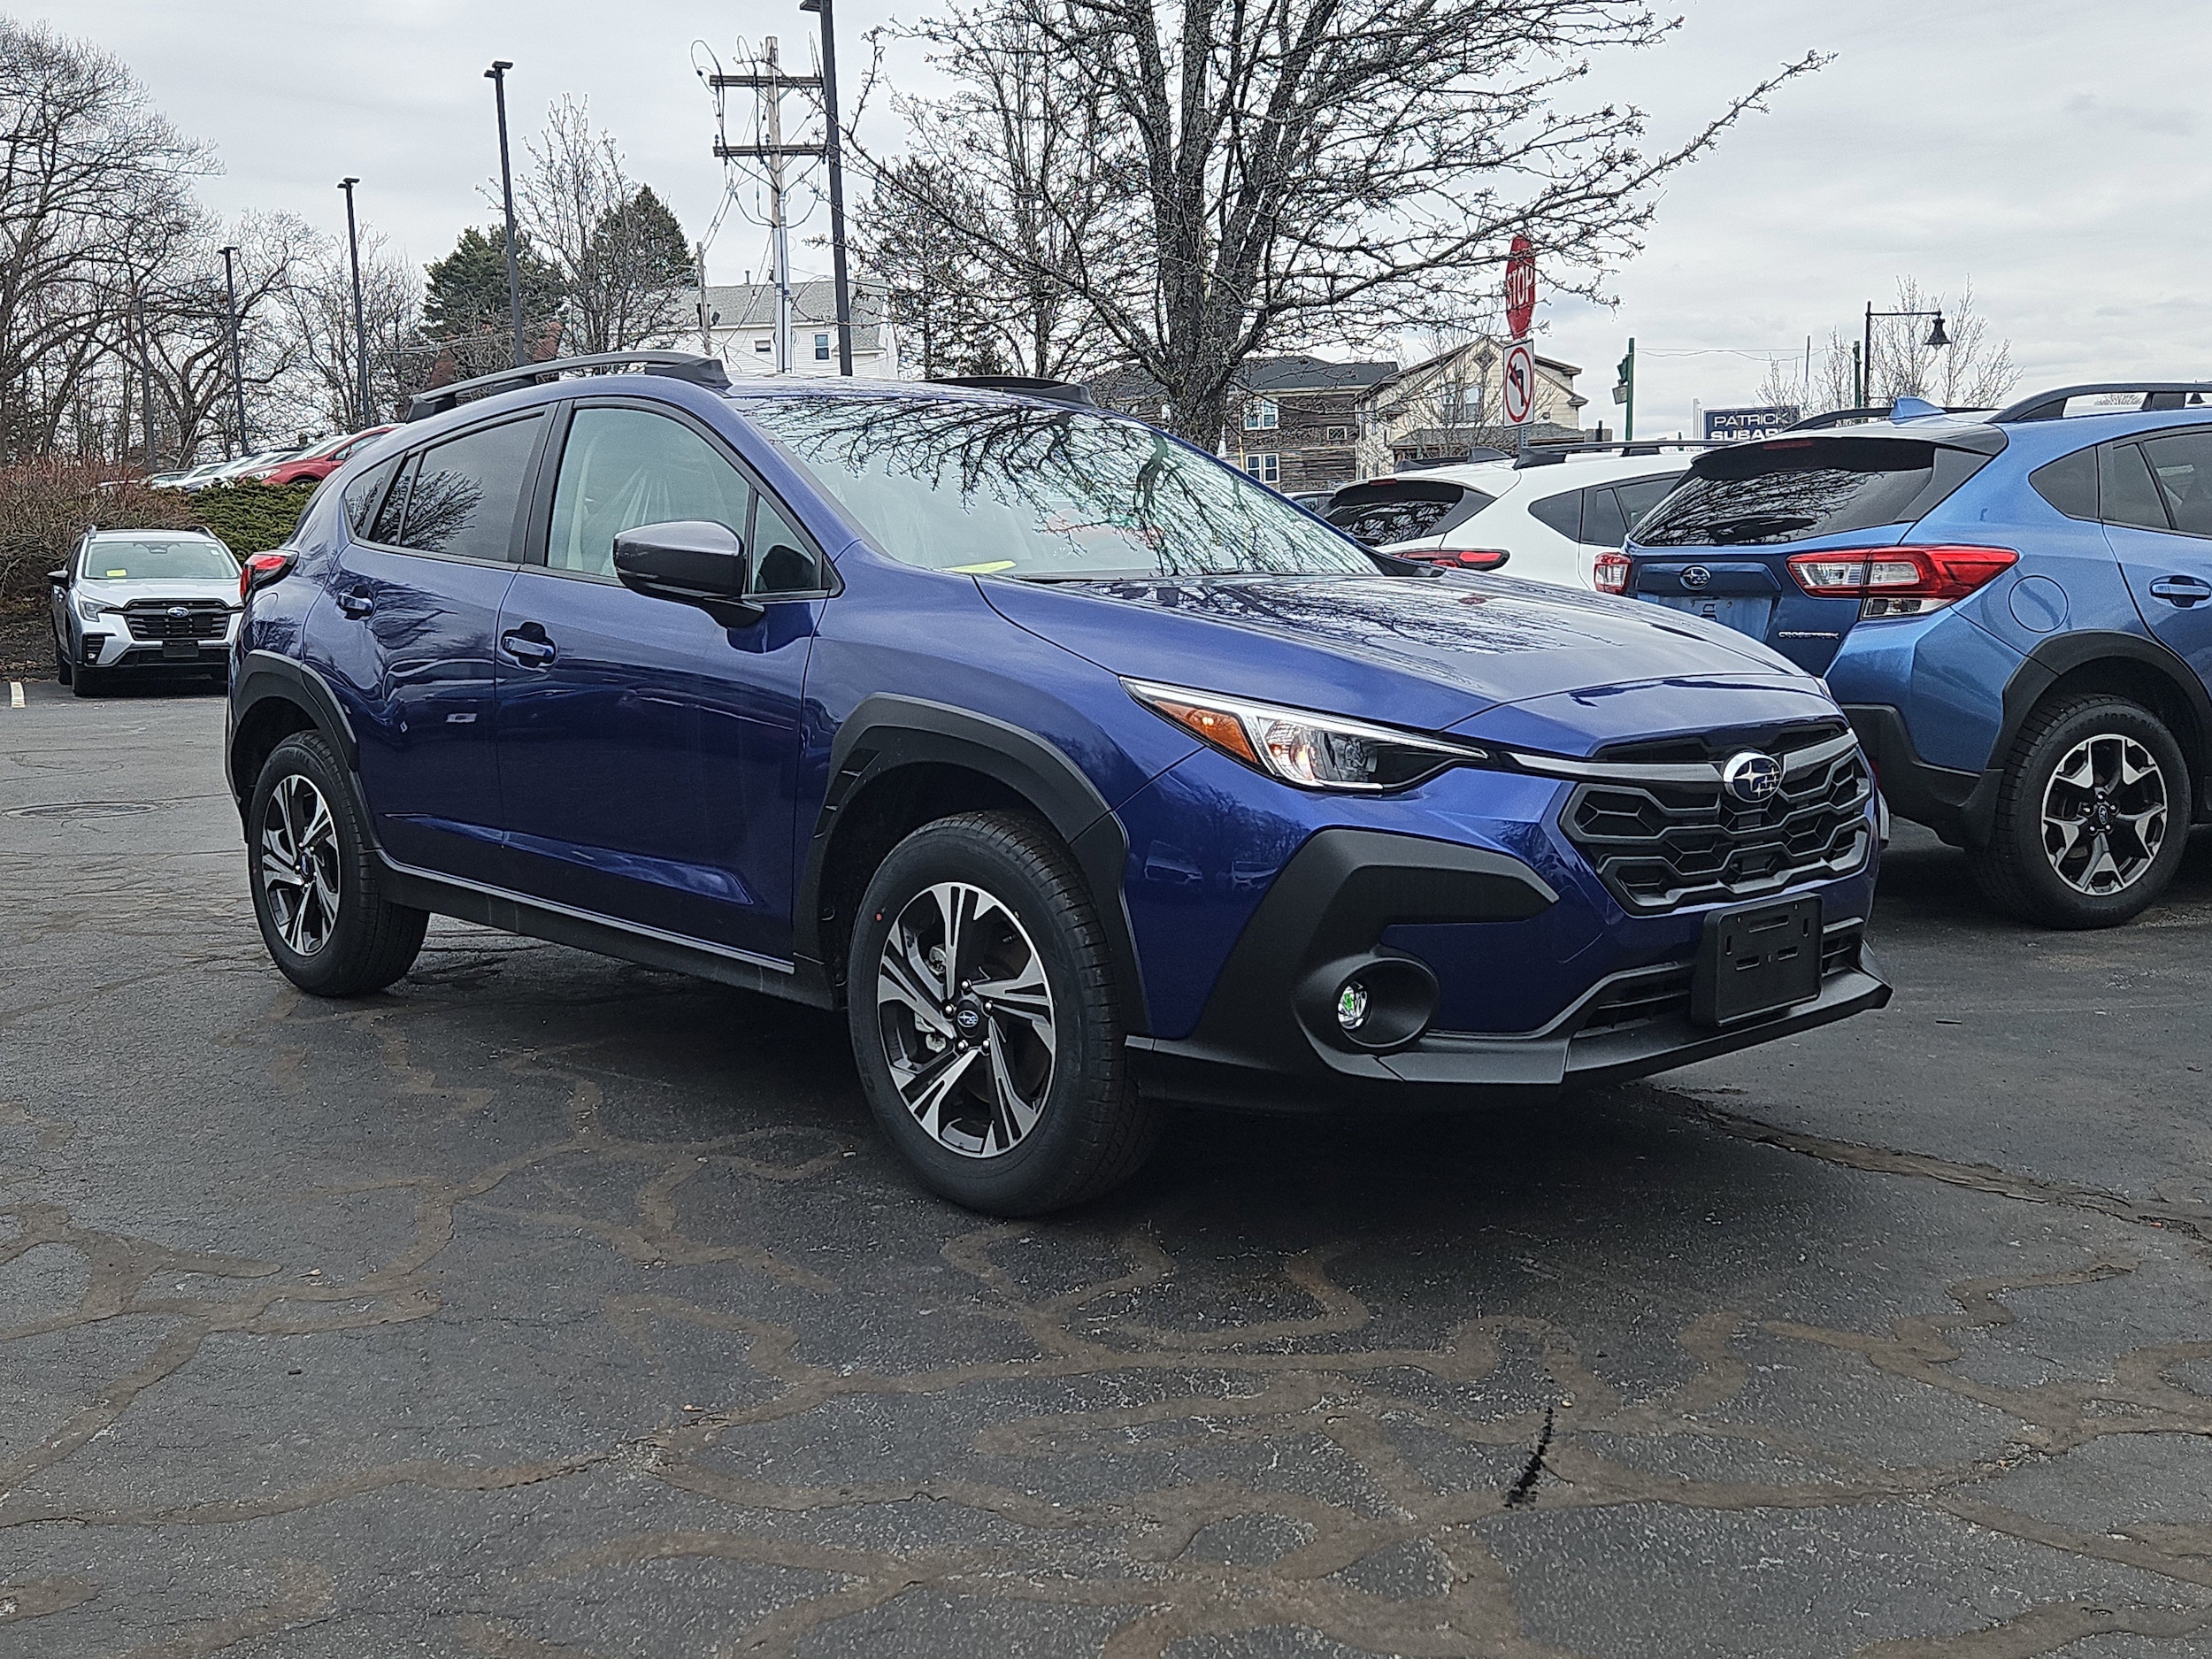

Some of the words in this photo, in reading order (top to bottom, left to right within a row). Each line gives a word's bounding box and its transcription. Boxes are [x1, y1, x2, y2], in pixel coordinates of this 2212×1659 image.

[1507, 265, 1534, 310] STOP
[1714, 411, 1788, 427] PATRICK
[1710, 427, 1783, 441] SUBAR
